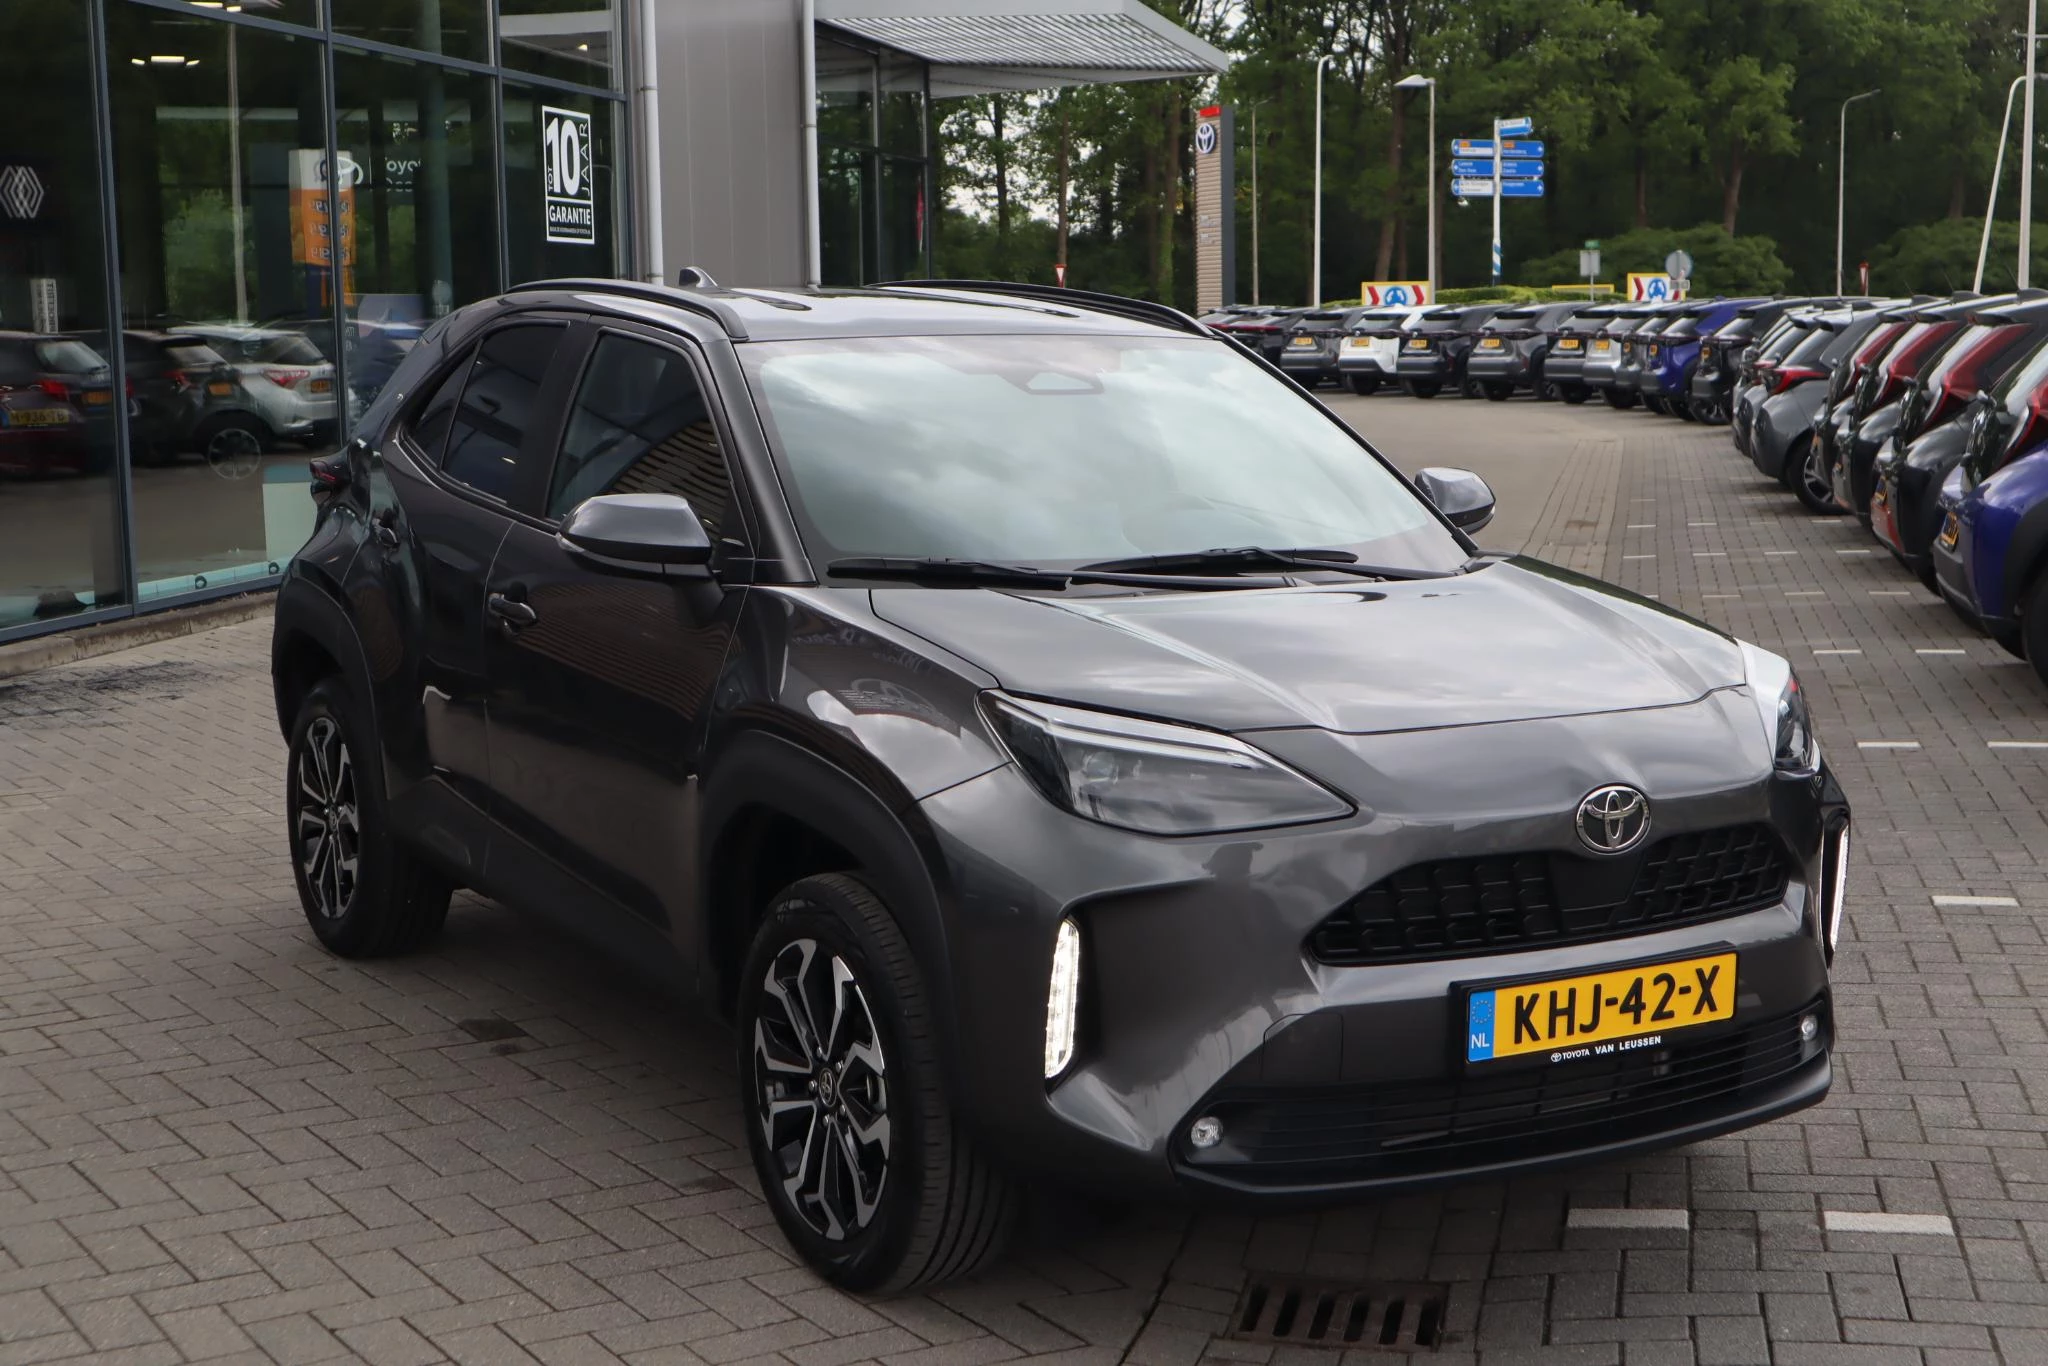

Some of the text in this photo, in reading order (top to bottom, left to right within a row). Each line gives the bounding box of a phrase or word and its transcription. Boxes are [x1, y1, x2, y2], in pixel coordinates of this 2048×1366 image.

[546, 117, 580, 196] 10
[580, 122, 590, 196] JAAR
[549, 205, 591, 225] GARANTIE
[1514, 964, 1720, 1045] KHJ-42-X
[1471, 1033, 1490, 1049] NL
[1562, 1035, 1662, 1061] TOYOTA VAN LEUSSEN
